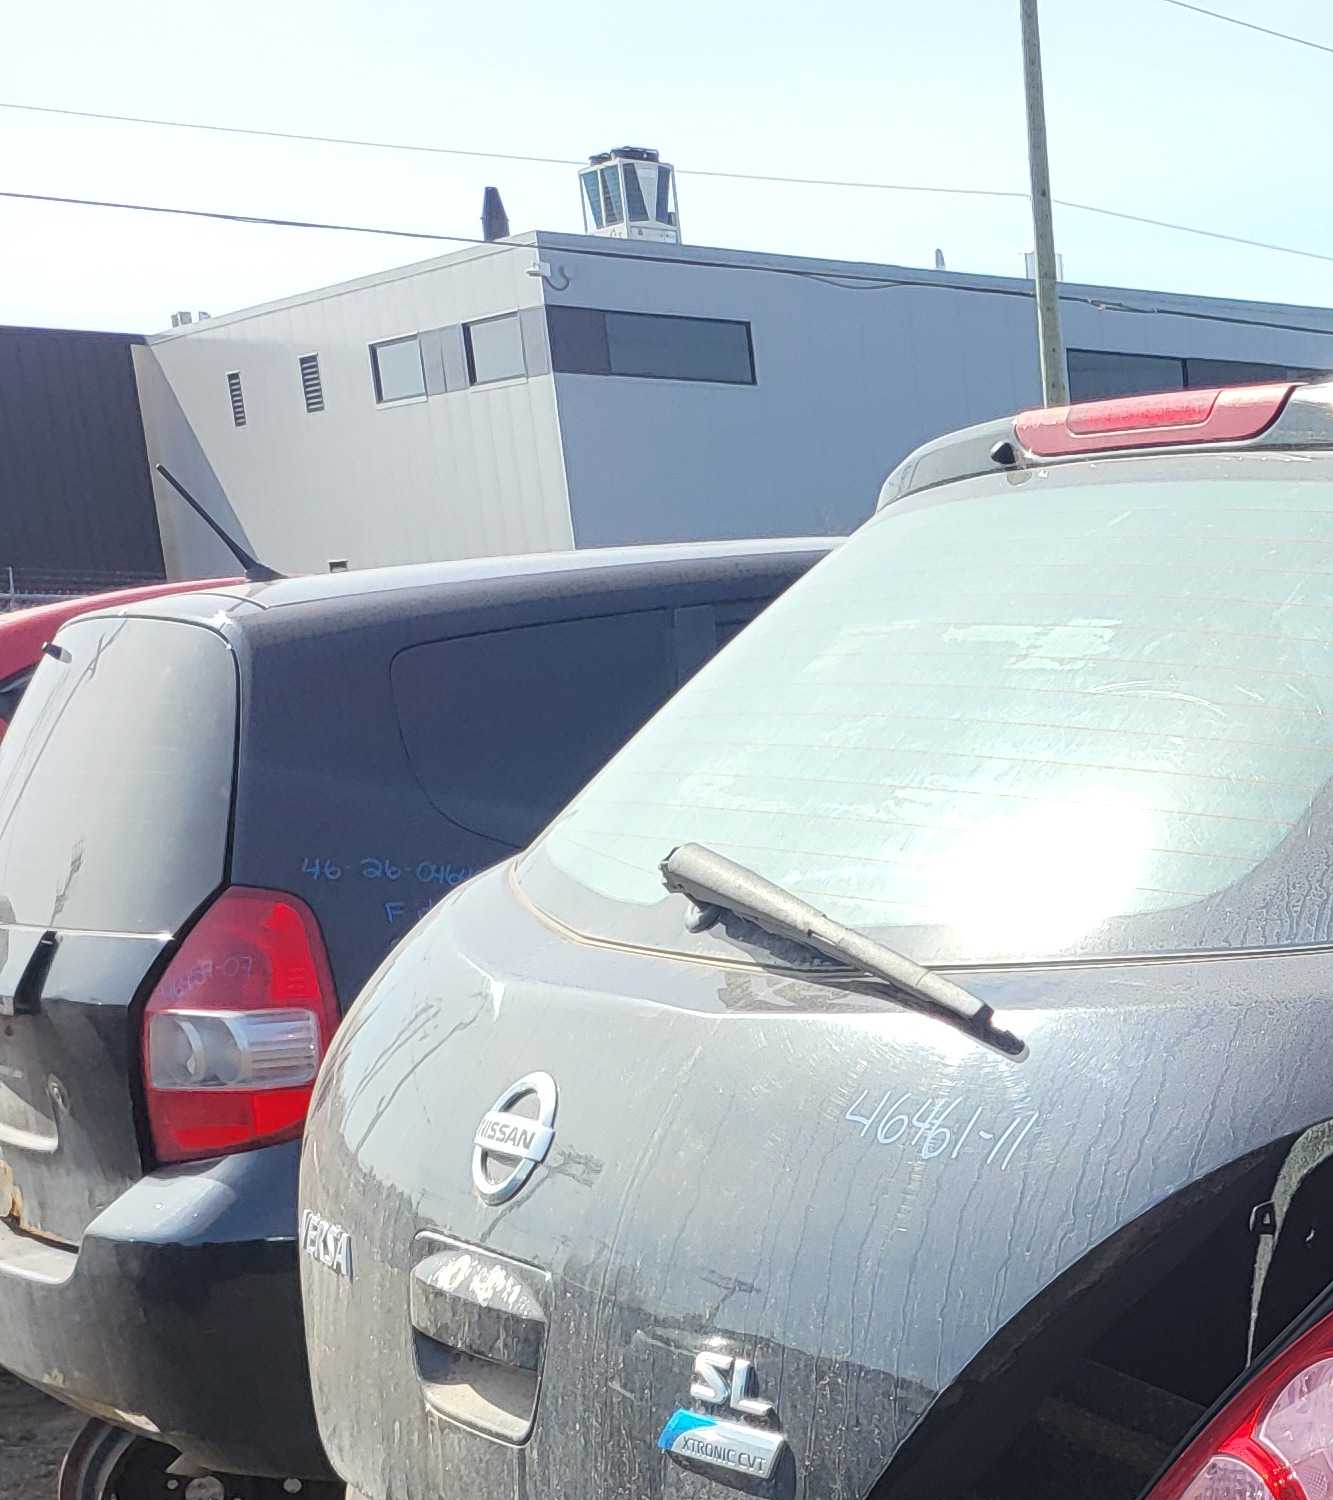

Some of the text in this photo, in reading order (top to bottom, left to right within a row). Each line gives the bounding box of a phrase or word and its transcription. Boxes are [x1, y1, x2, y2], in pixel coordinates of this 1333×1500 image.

[846, 1089, 1038, 1170] 46461-11
[690, 1351, 774, 1416] SL
[682, 1437, 767, 1473] XTRONIC CVT
